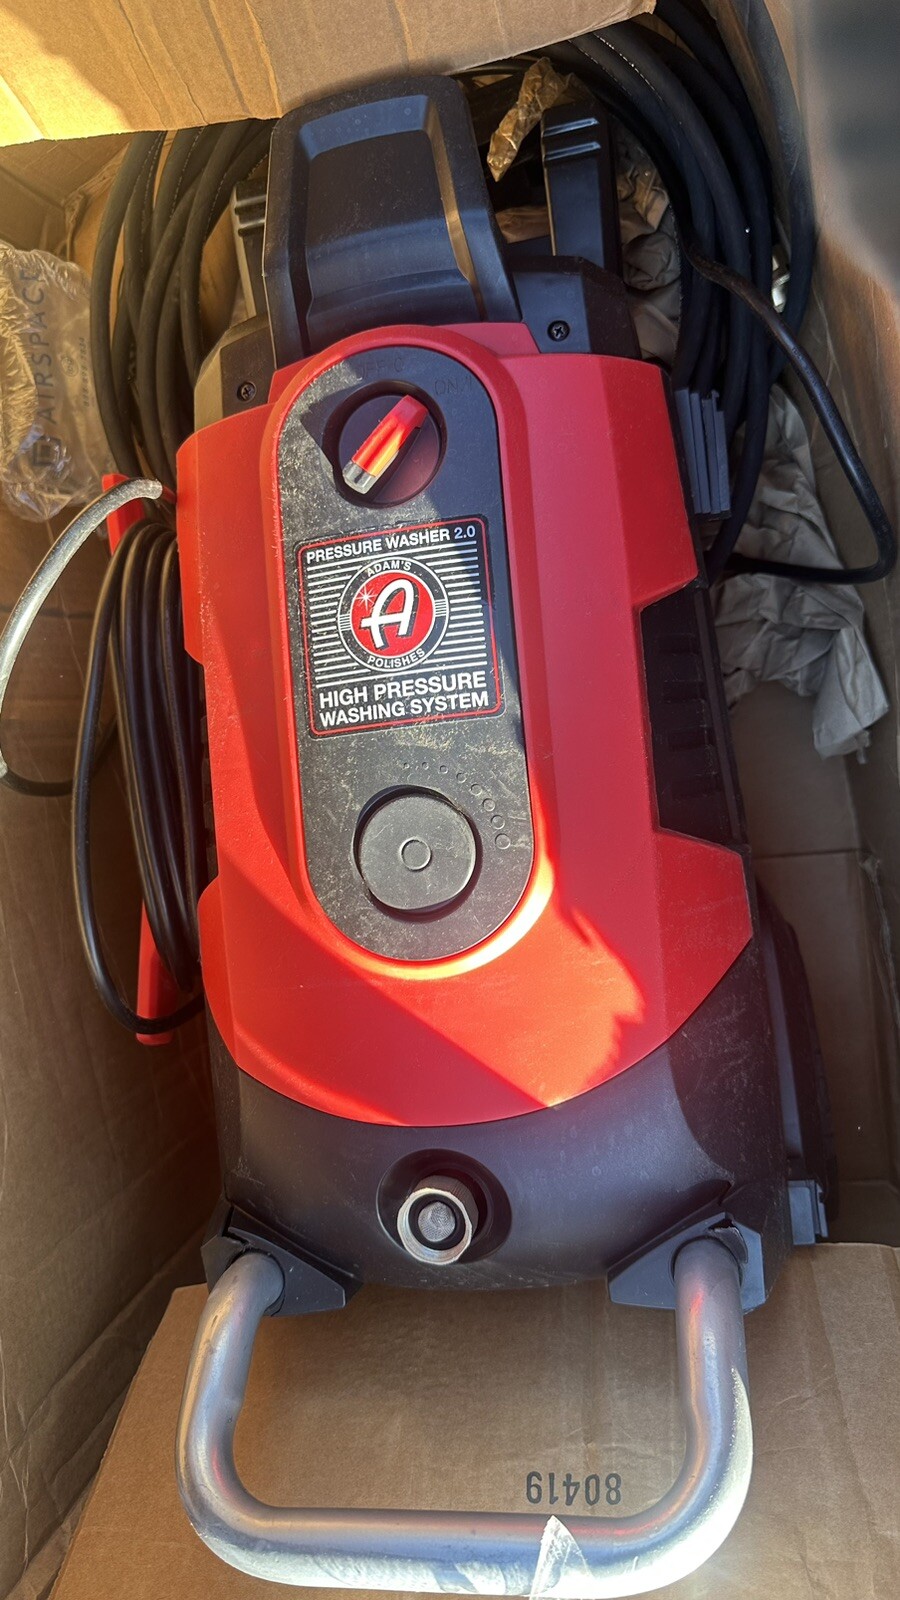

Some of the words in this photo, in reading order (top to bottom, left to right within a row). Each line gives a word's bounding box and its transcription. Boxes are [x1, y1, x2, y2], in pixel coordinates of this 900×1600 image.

[19, 266, 57, 426] AIRSPACE
[306, 538, 382, 564] PRESSURE
[385, 528, 450, 550] WASHER
[454, 525, 476, 540] 2.0
[366, 559, 412, 577] ADAM'S
[367, 647, 426, 669] POLISHES
[319, 685, 368, 709] HIGH
[374, 671, 487, 700] PRESSURE
[320, 704, 406, 728] WASHING
[410, 696, 489, 714] SYSTEM
[526, 1470, 622, 1506] 80419
